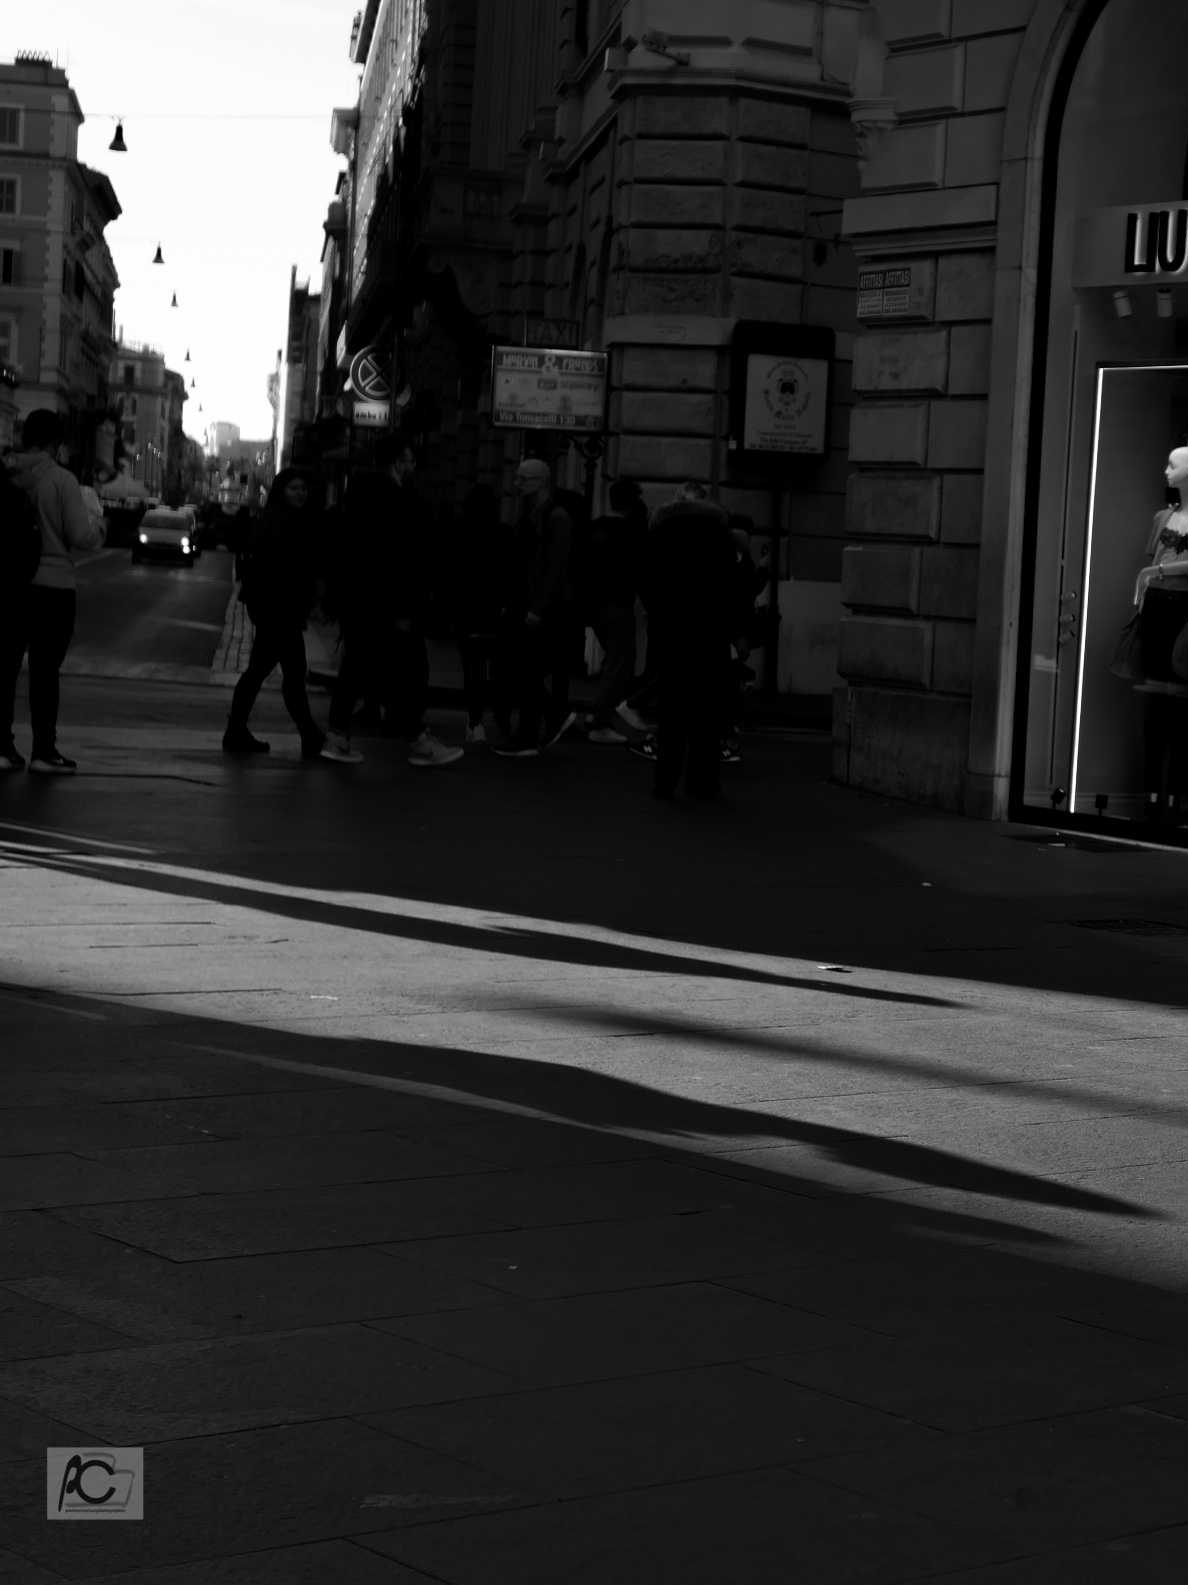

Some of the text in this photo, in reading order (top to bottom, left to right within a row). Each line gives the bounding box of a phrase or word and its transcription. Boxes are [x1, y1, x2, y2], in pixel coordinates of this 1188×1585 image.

[531, 322, 574, 343] TAXI
[541, 355, 559, 375] &
[499, 411, 513, 421] Via
